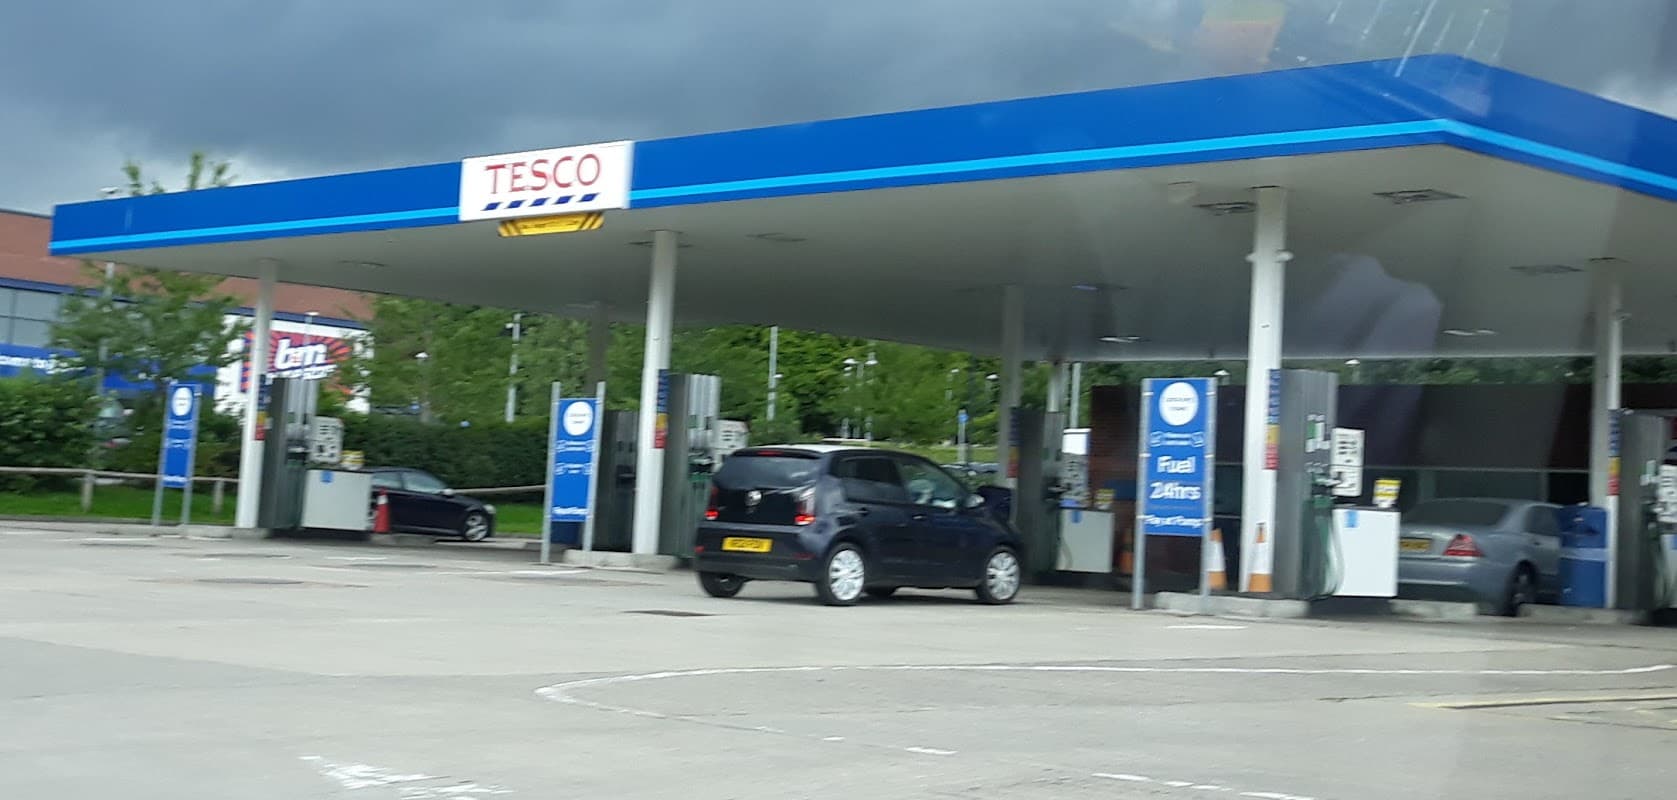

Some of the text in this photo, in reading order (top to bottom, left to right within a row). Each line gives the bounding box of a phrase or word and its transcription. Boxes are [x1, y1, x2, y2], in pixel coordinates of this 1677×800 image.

[486, 153, 602, 194] TESCO
[1157, 456, 1196, 474] Fuel
[1149, 482, 1202, 500] 24hrs
